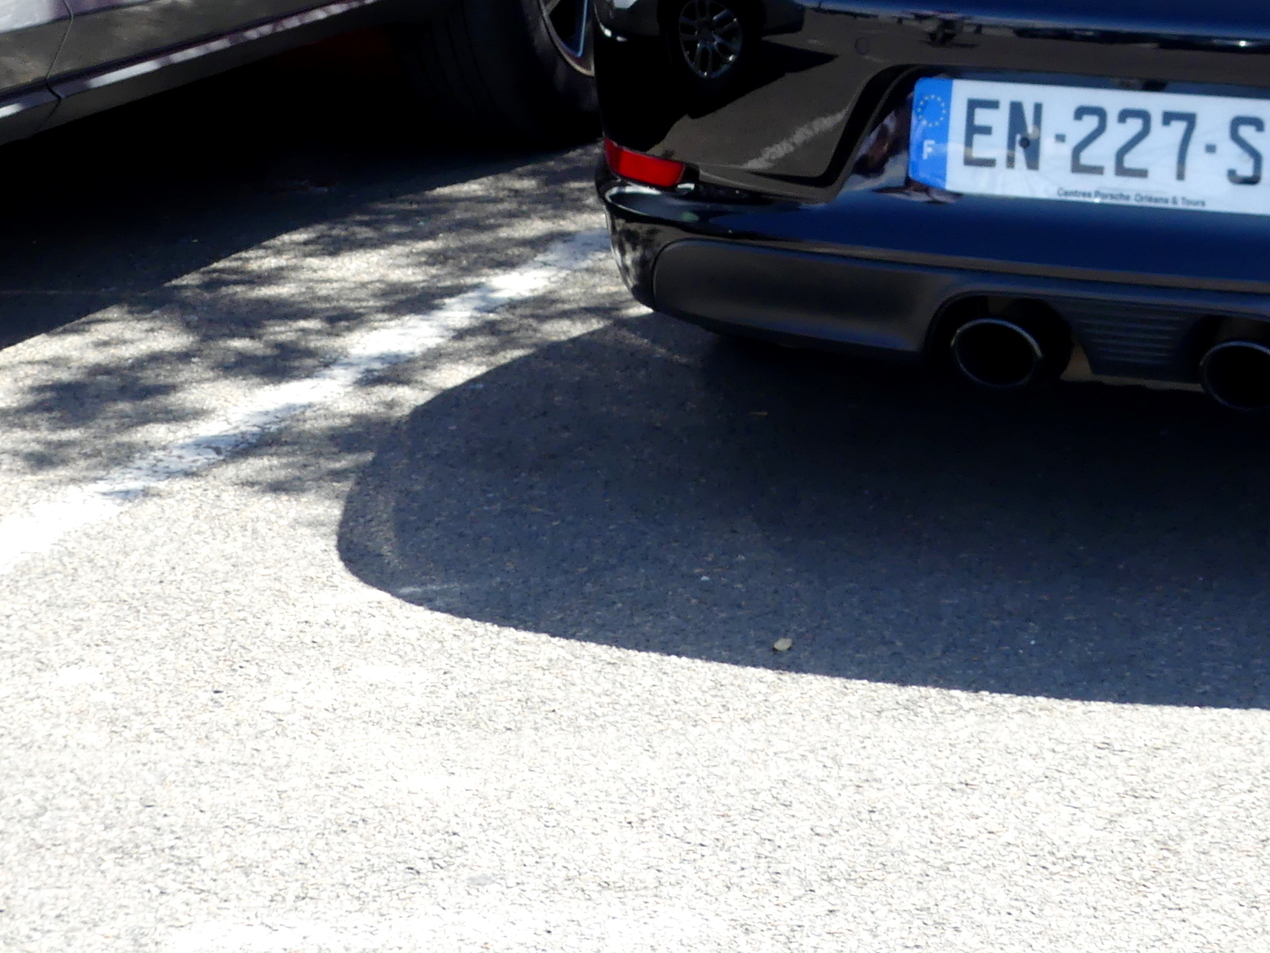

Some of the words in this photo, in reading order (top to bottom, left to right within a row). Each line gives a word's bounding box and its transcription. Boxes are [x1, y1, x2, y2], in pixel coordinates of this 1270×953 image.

[922, 138, 936, 161] F
[1056, 186, 1092, 198] Centres
[1094, 189, 1131, 201] Porsche
[1171, 197, 1178, 206] &
[1180, 196, 1206, 207] Tours
